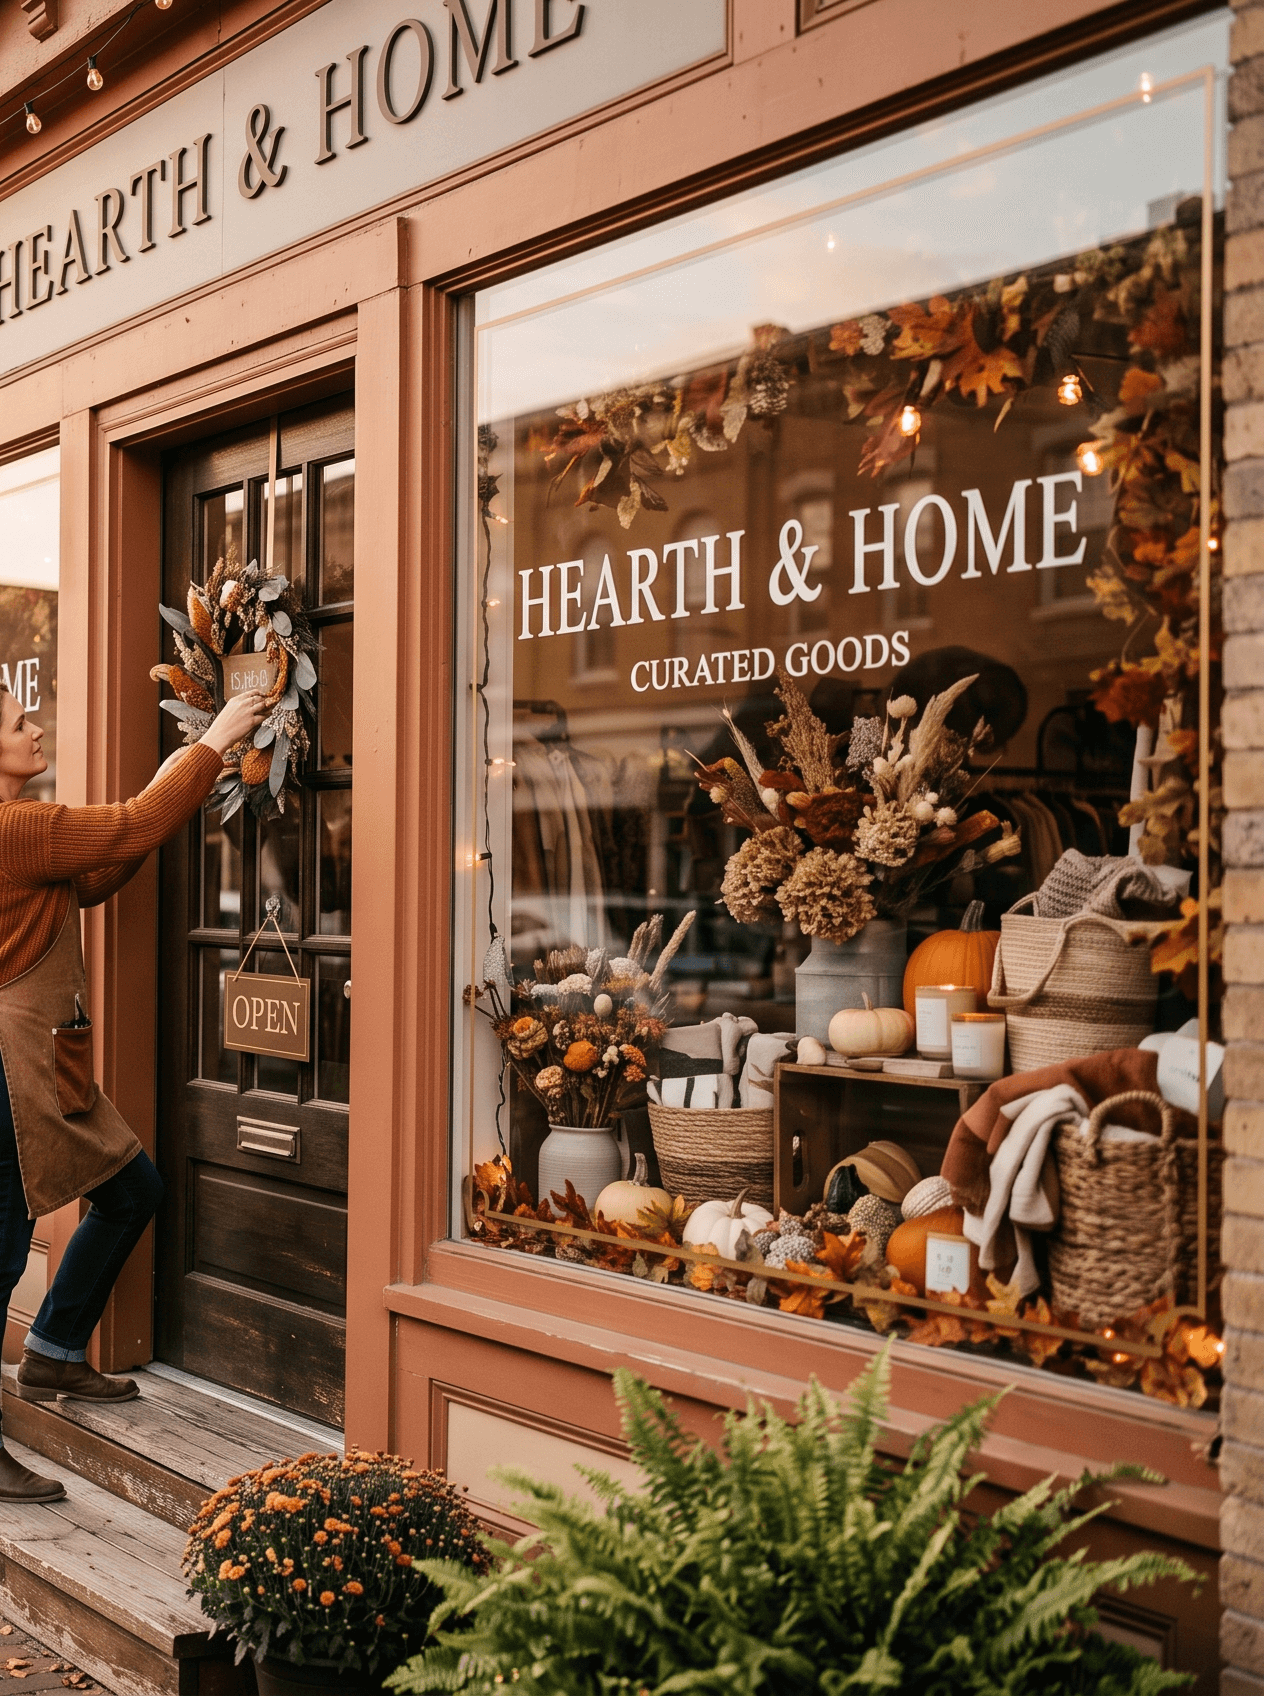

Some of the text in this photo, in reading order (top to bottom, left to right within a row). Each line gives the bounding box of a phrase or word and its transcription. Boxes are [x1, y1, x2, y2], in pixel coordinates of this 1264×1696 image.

[237, 102, 288, 199] &
[517, 470, 1088, 641] HEARTH & HOME
[629, 630, 911, 693] CURATED GOODS
[232, 995, 300, 1036] OPEN
